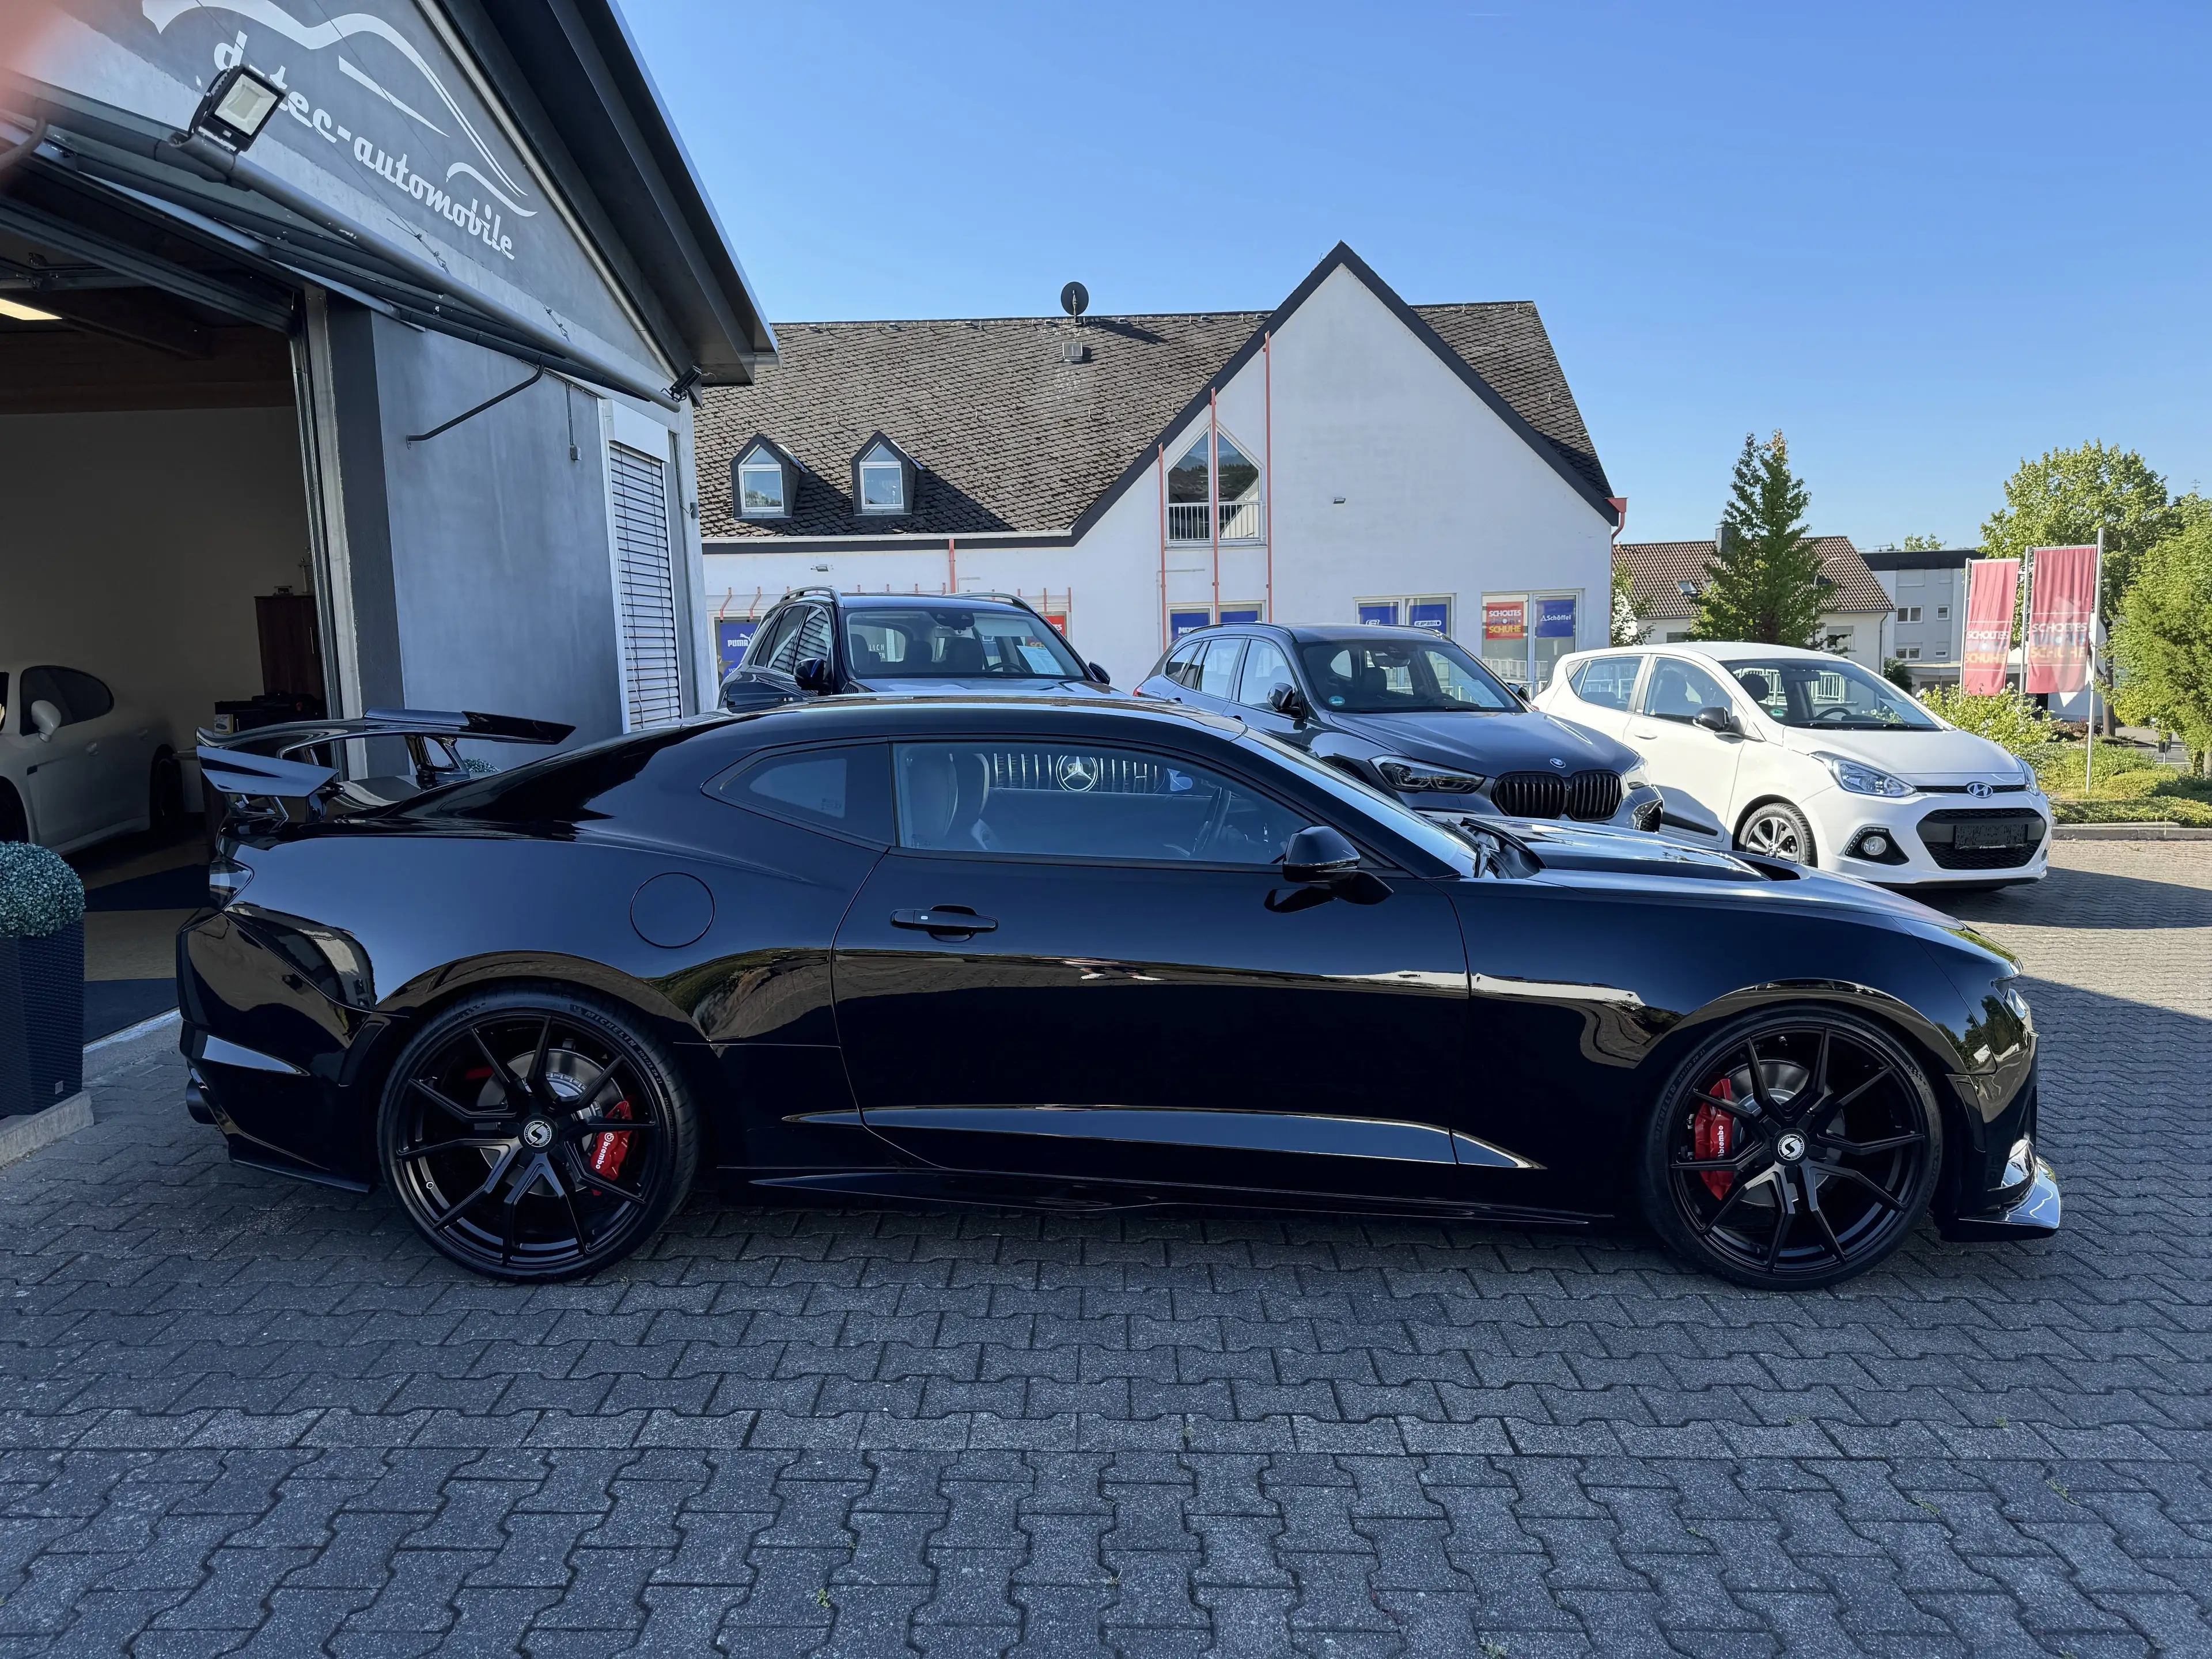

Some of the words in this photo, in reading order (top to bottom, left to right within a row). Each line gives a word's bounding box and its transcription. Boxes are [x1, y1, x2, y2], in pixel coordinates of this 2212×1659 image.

[728, 639, 749, 647] PUMA
[1488, 626, 1521, 634] SCHUHE
[584, 1011, 637, 1047] MICHELIN
[1654, 1084, 1677, 1140] MICHELIN
[595, 1142, 611, 1169] brembo
